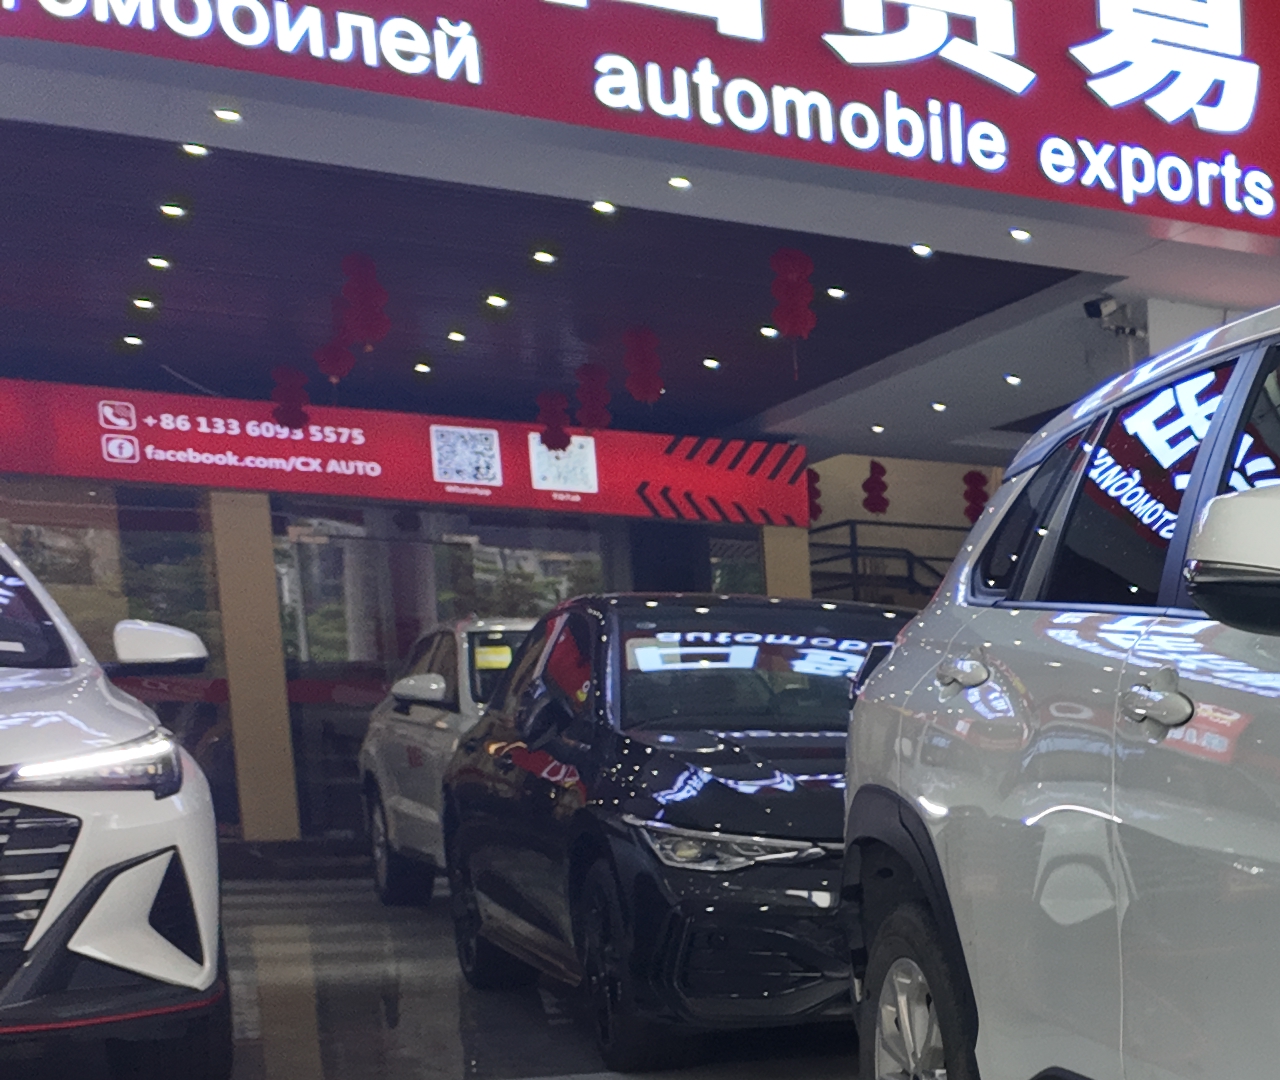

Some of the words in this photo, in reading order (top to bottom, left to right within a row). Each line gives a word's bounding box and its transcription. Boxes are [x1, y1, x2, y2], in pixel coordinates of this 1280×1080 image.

[0, 0, 483, 85] мобилей
[593, 52, 1009, 172] automobile
[1038, 134, 1277, 217] exports
[143, 413, 191, 431] +86
[196, 415, 241, 436] 133
[308, 424, 367, 445] 5575
[144, 444, 323, 473] facebook.com/CX
[326, 457, 382, 477] AUTO
